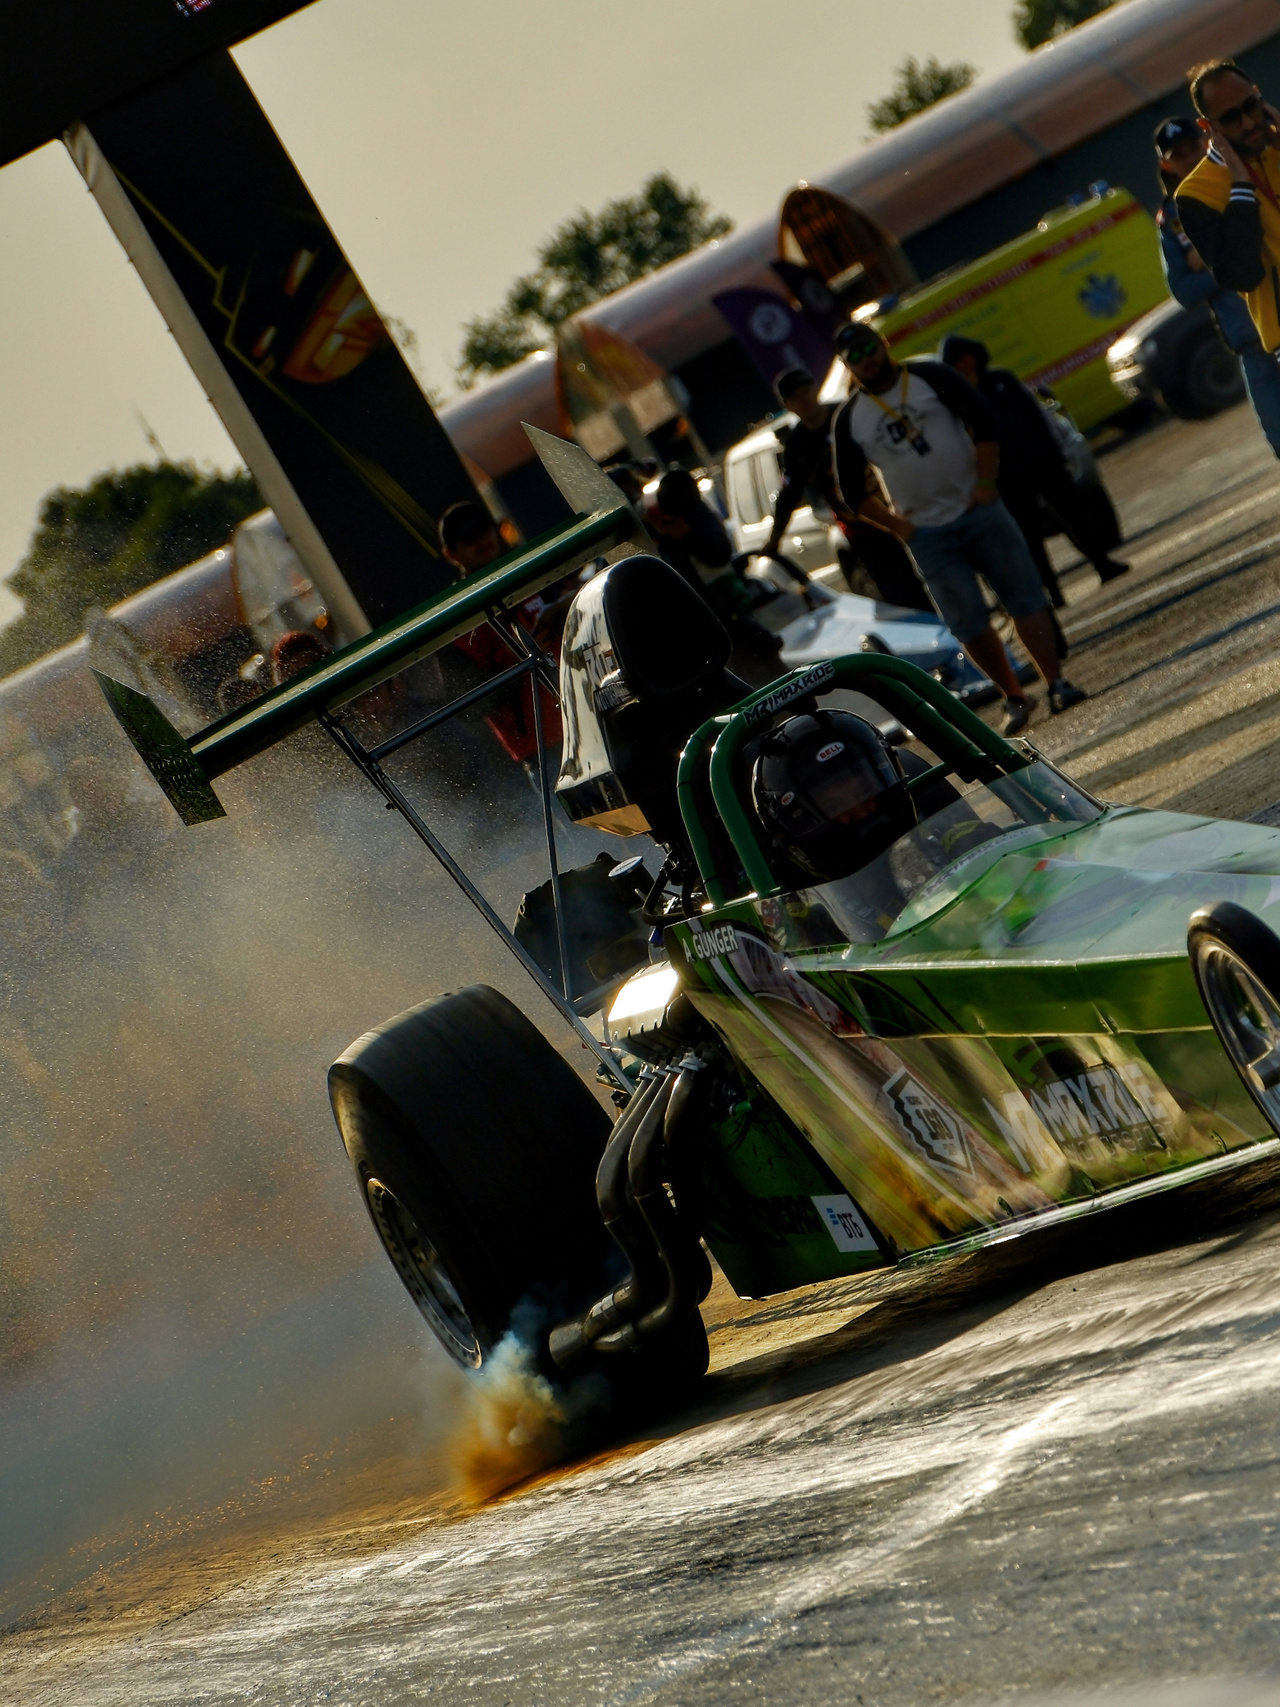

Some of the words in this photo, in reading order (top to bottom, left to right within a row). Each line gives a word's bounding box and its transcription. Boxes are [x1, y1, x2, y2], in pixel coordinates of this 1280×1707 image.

[819, 744, 842, 760] BELL
[692, 925, 739, 959] GUNGER
[837, 1212, 865, 1239] ВТБ
